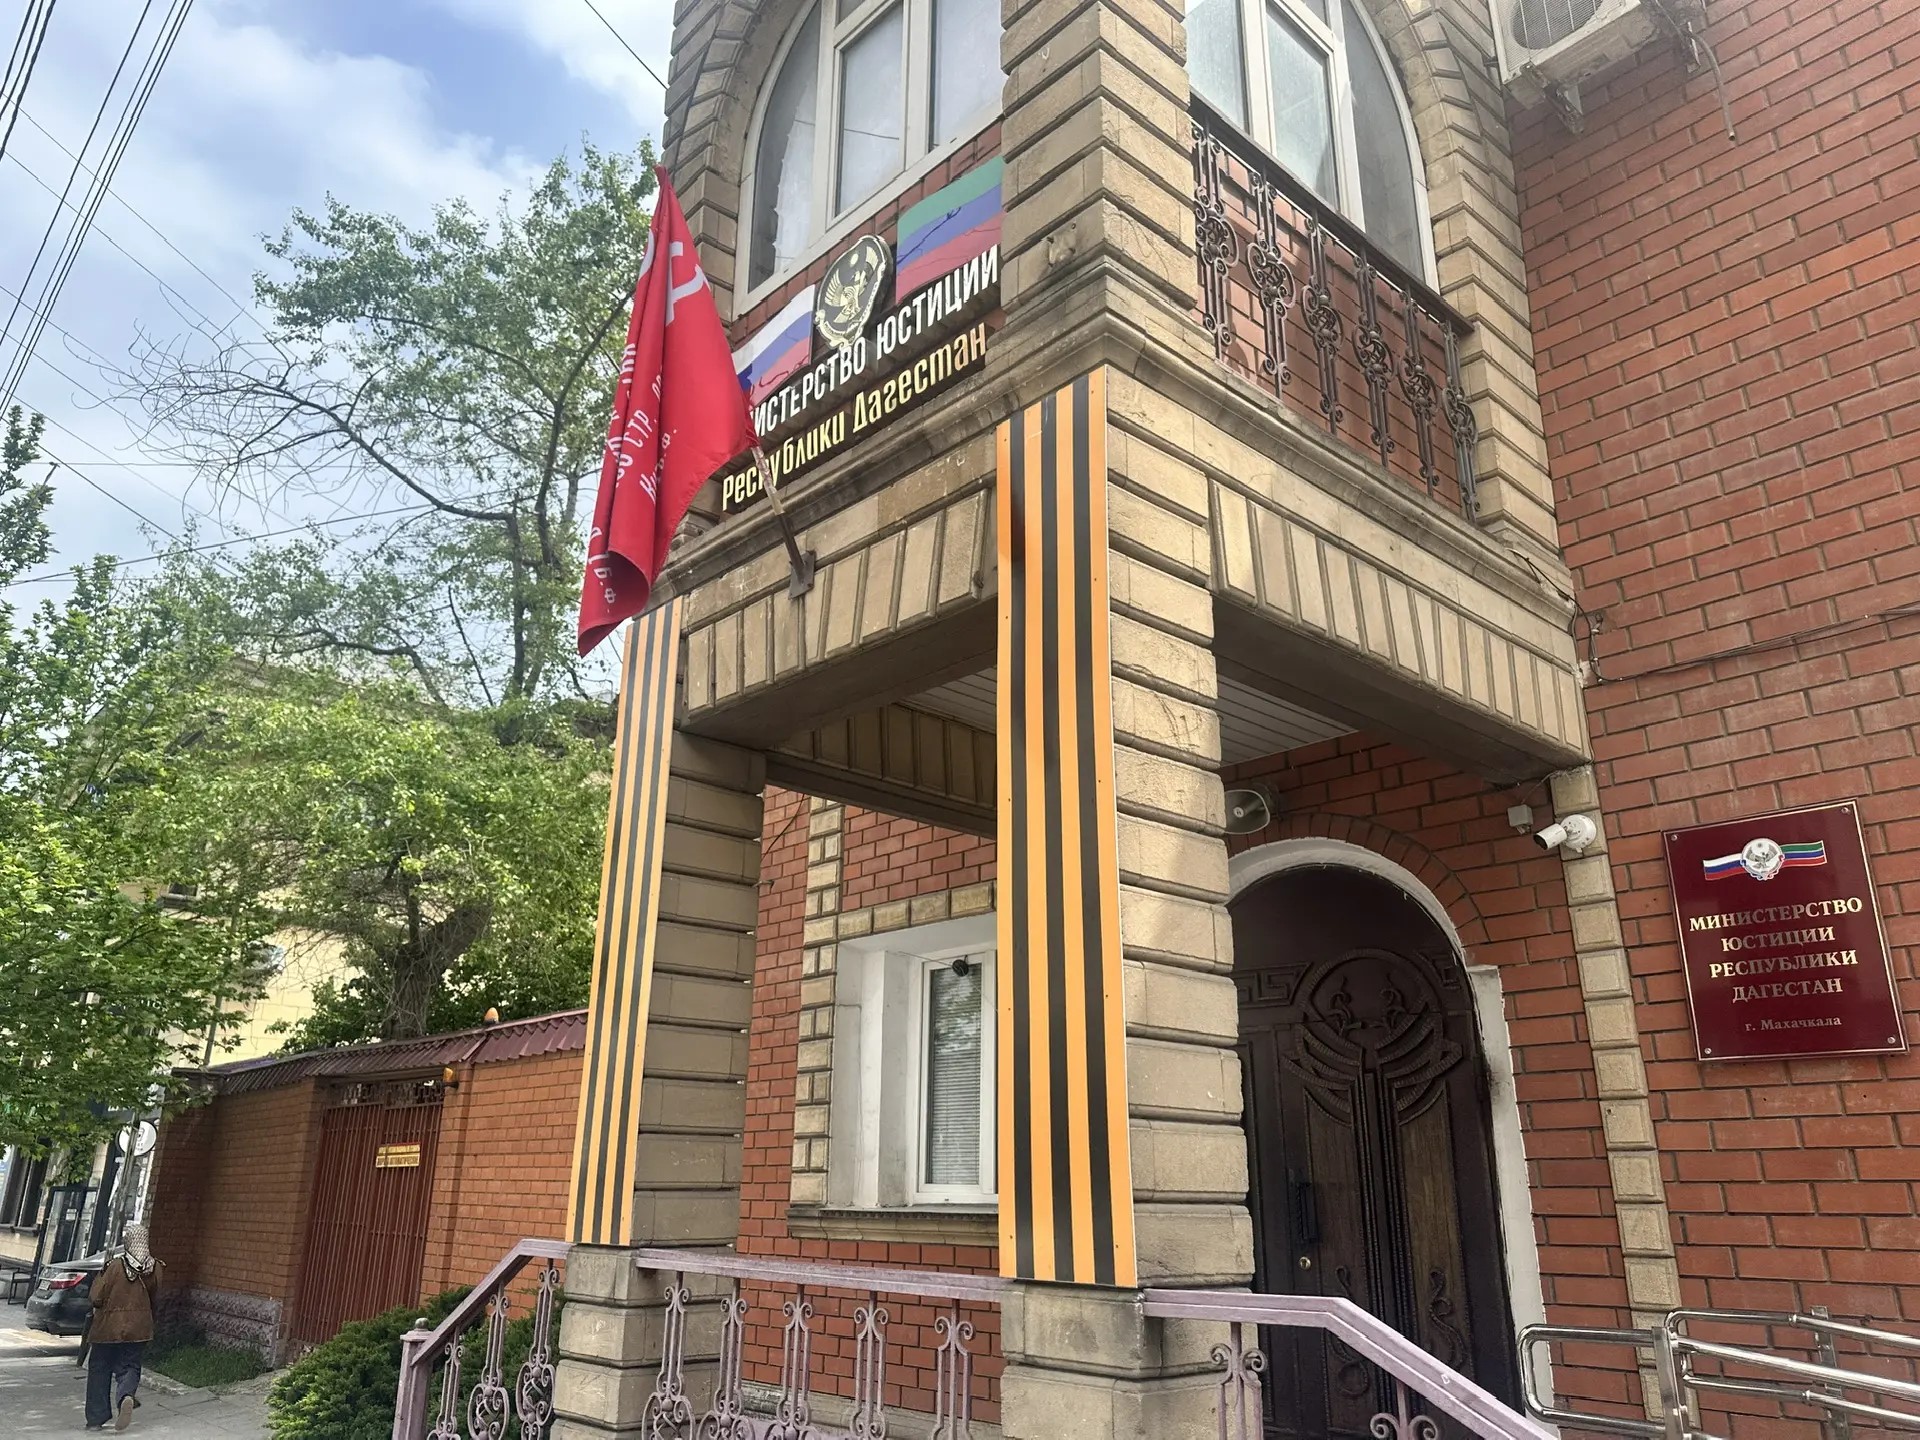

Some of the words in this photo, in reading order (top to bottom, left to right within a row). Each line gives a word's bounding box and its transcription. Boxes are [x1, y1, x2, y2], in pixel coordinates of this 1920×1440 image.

[750, 336, 867, 437] ИСТЕРСТВО
[876, 243, 998, 361] ЮСТИЦИИ
[853, 322, 987, 434] Дагестан
[1688, 896, 1864, 932] МИНИСТЕРСТВО
[1720, 926, 1836, 952] ЮСТИЦИИ
[1709, 949, 1859, 979] РЕСПУБЛИКИ
[1732, 977, 1844, 1004] ДАГЕСТАН
[1745, 1022, 1757, 1032] г.
[1760, 1014, 1843, 1031] Махачкала
